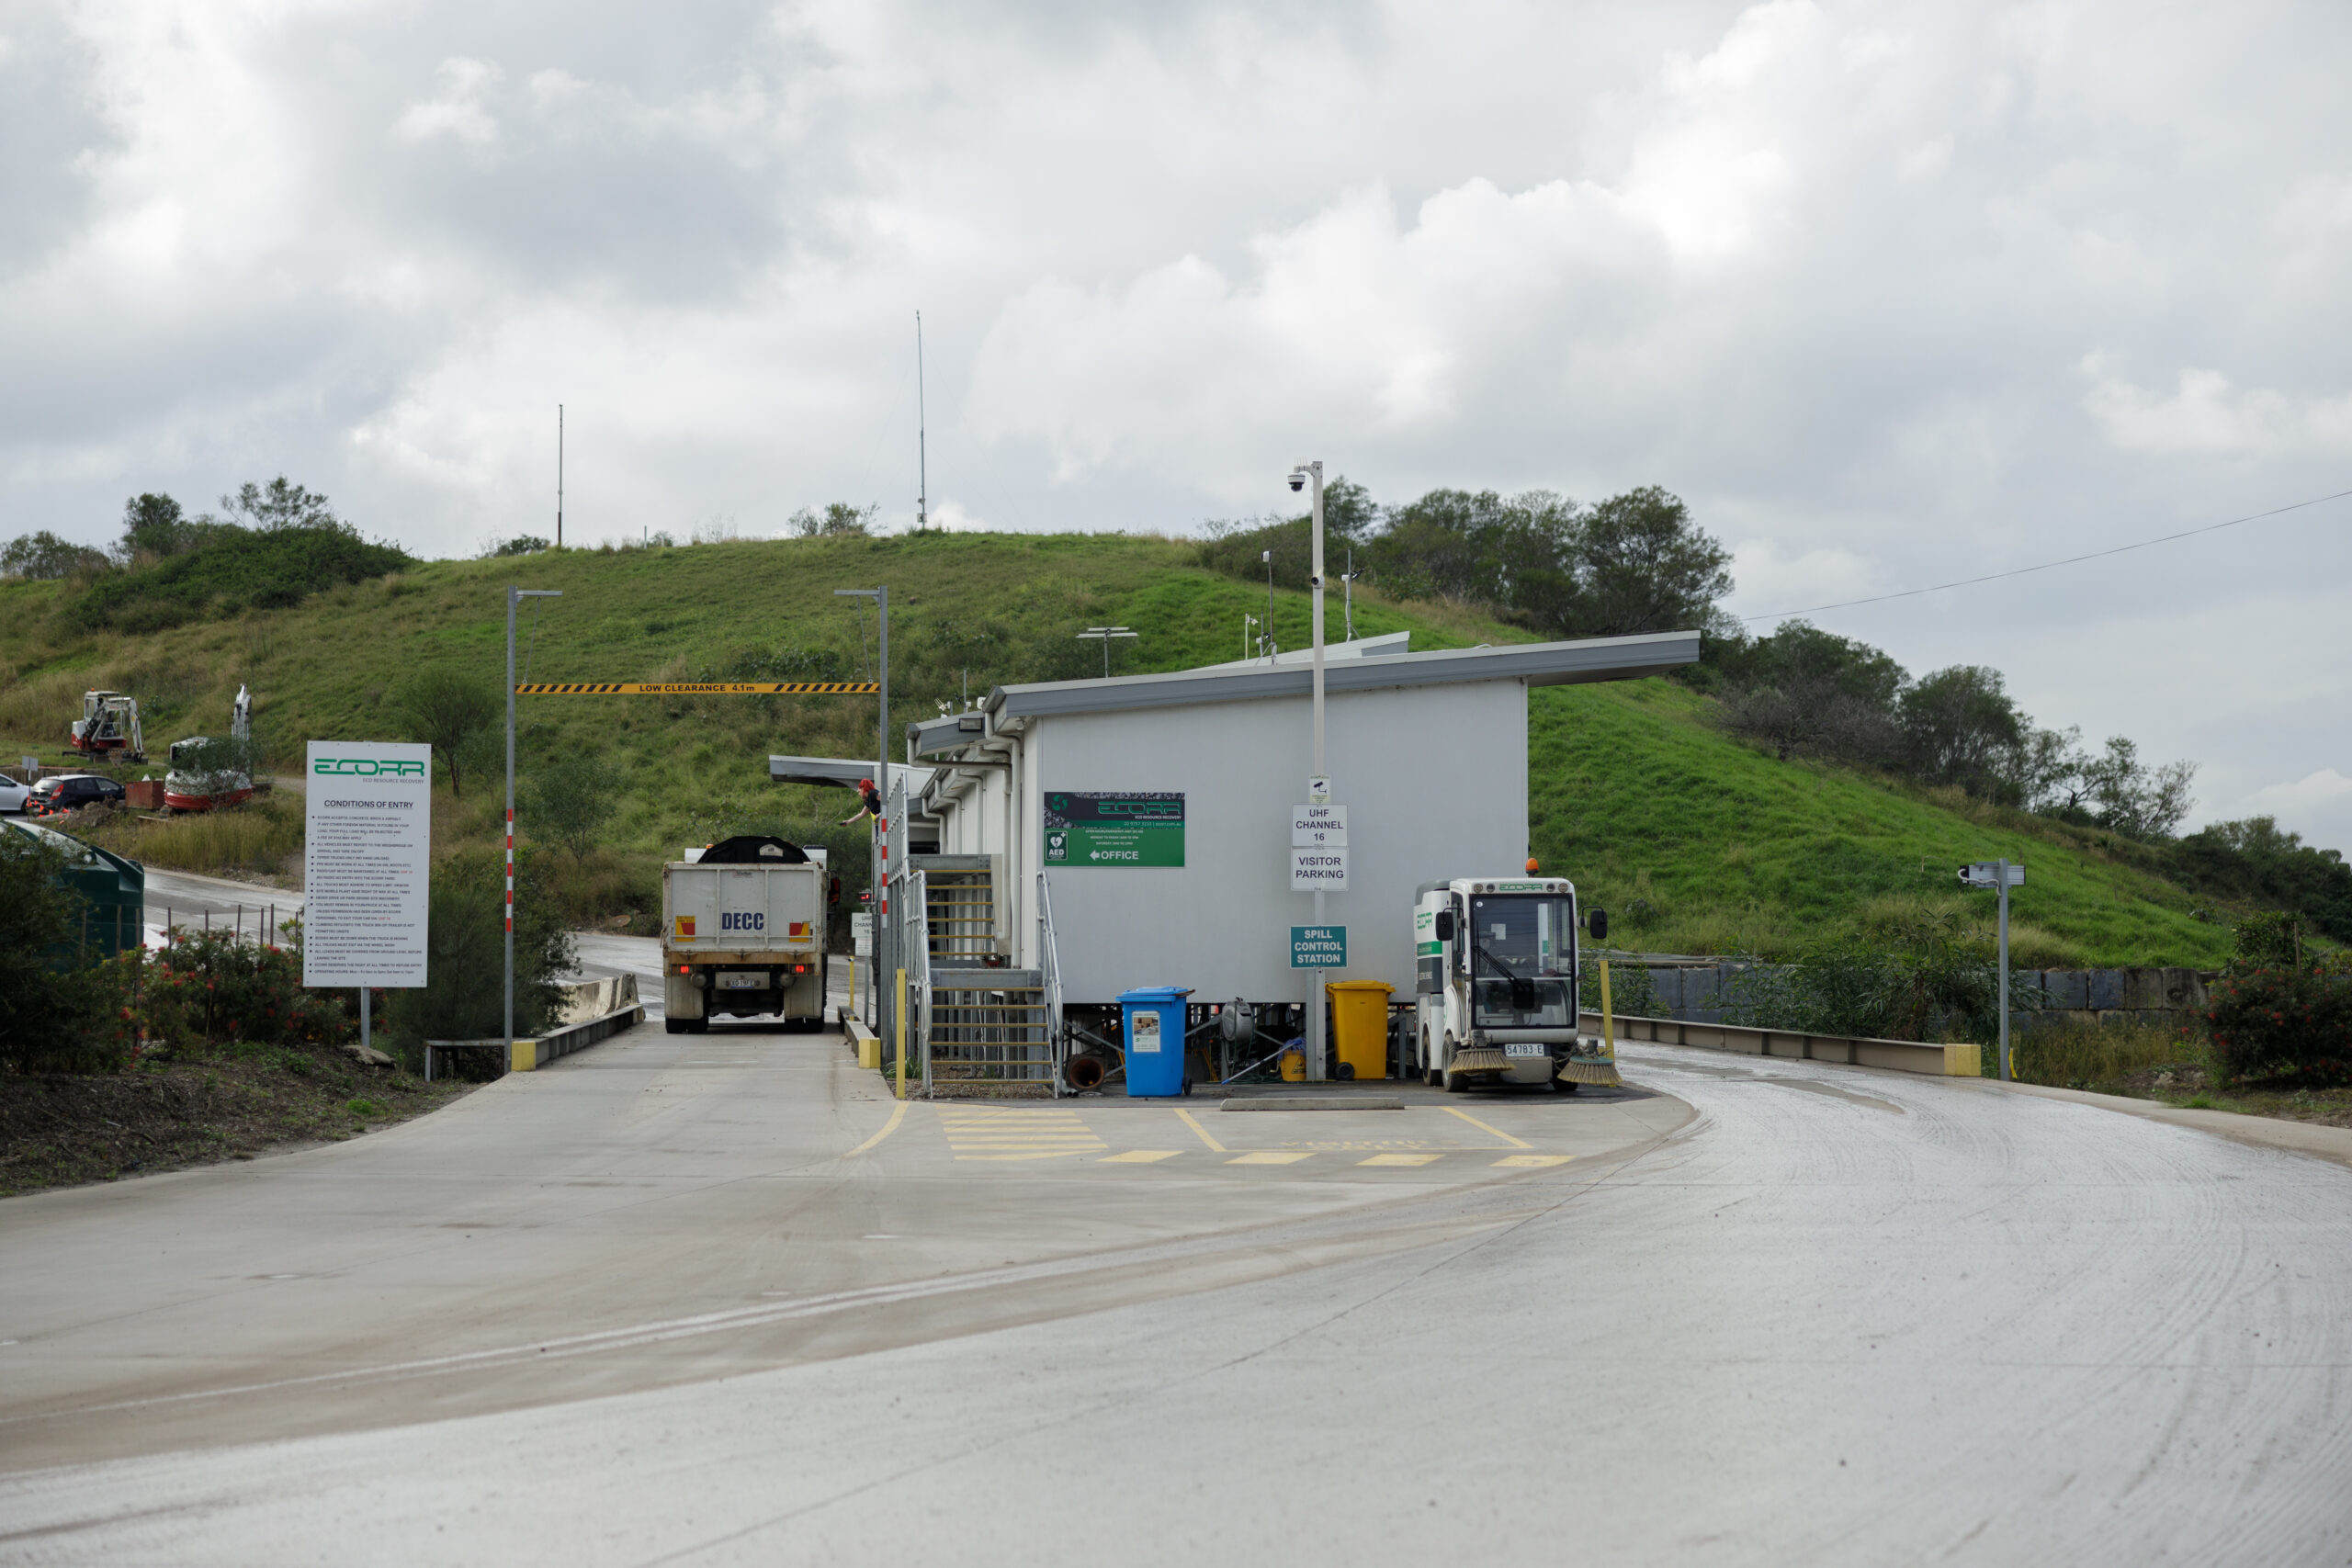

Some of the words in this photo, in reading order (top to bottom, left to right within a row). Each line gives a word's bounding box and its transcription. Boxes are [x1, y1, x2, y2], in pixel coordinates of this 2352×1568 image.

[314, 759, 424, 777] ECORR
[324, 800, 375, 808] CONDITIONS
[1098, 801, 1182, 815] ECORR
[1295, 820, 1343, 829] CHANNEL
[1101, 851, 1139, 860] OFFICE
[1298, 857, 1341, 865] VISITOR
[1295, 870, 1344, 878] PARKING
[721, 912, 764, 930] DECC
[1305, 930, 1333, 939] SPILL
[1295, 942, 1342, 951] CONTROL
[1297, 953, 1340, 963] STATION
